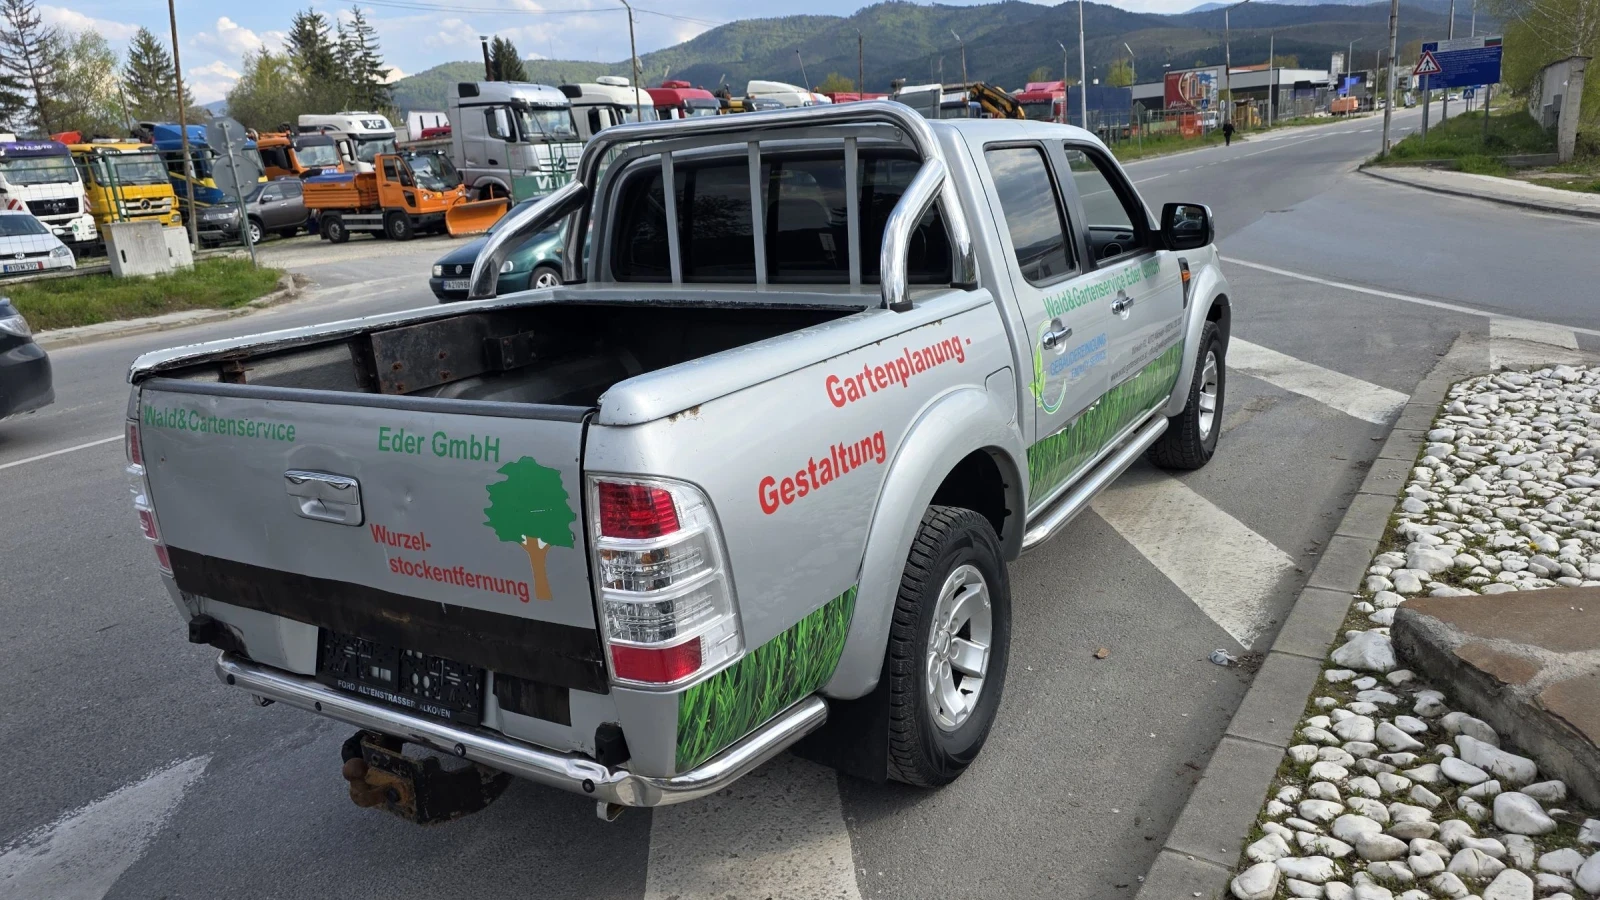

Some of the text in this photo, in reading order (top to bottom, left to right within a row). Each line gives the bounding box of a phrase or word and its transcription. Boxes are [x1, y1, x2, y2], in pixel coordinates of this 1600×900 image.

[367, 121, 381, 129] XF
[1043, 274, 1126, 319] Wald&Gartenservice
[1124, 266, 1142, 286] Eder
[825, 336, 965, 408] Gartenplanung
[378, 426, 425, 457] Eder
[432, 431, 500, 463] GmbH
[758, 430, 887, 515] Gestaltung
[370, 523, 432, 553] Wurzel-
[390, 555, 529, 603] stockentfernung
[337, 680, 450, 719] FORD ALTENSTRASSER ALKOVEN
